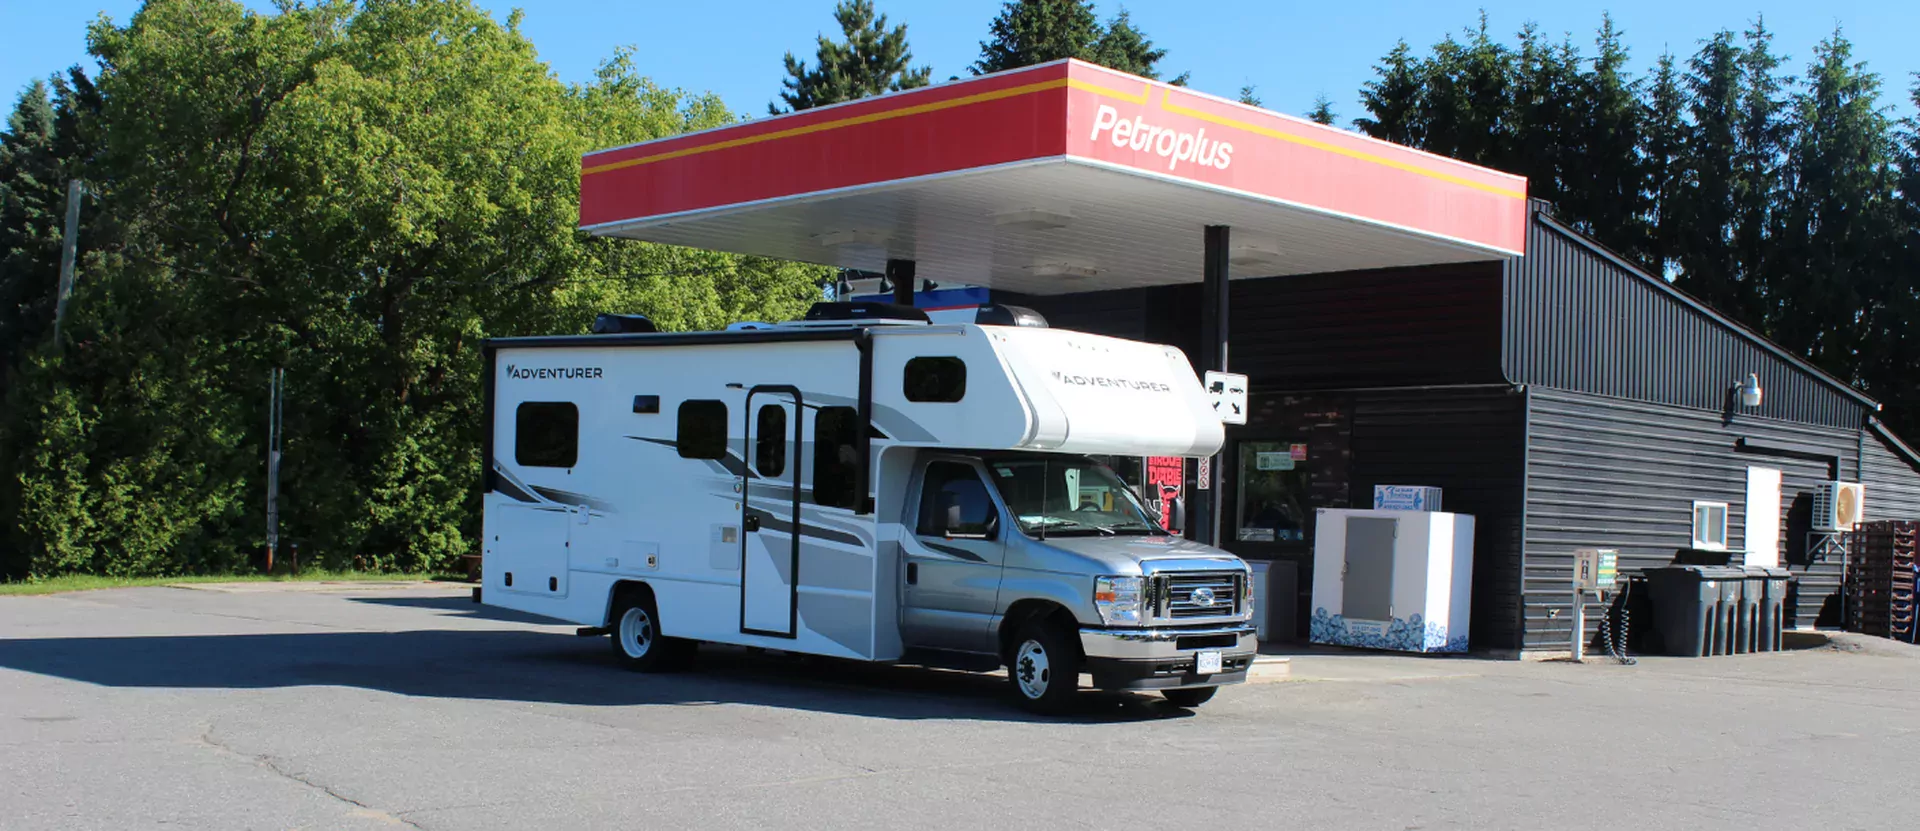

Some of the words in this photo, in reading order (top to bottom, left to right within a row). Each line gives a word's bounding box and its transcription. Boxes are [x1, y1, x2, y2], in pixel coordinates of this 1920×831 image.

[1090, 104, 1233, 170] Petroplus
[512, 367, 603, 379] ADVENTURER
[1064, 376, 1170, 392] ADVENTURER
